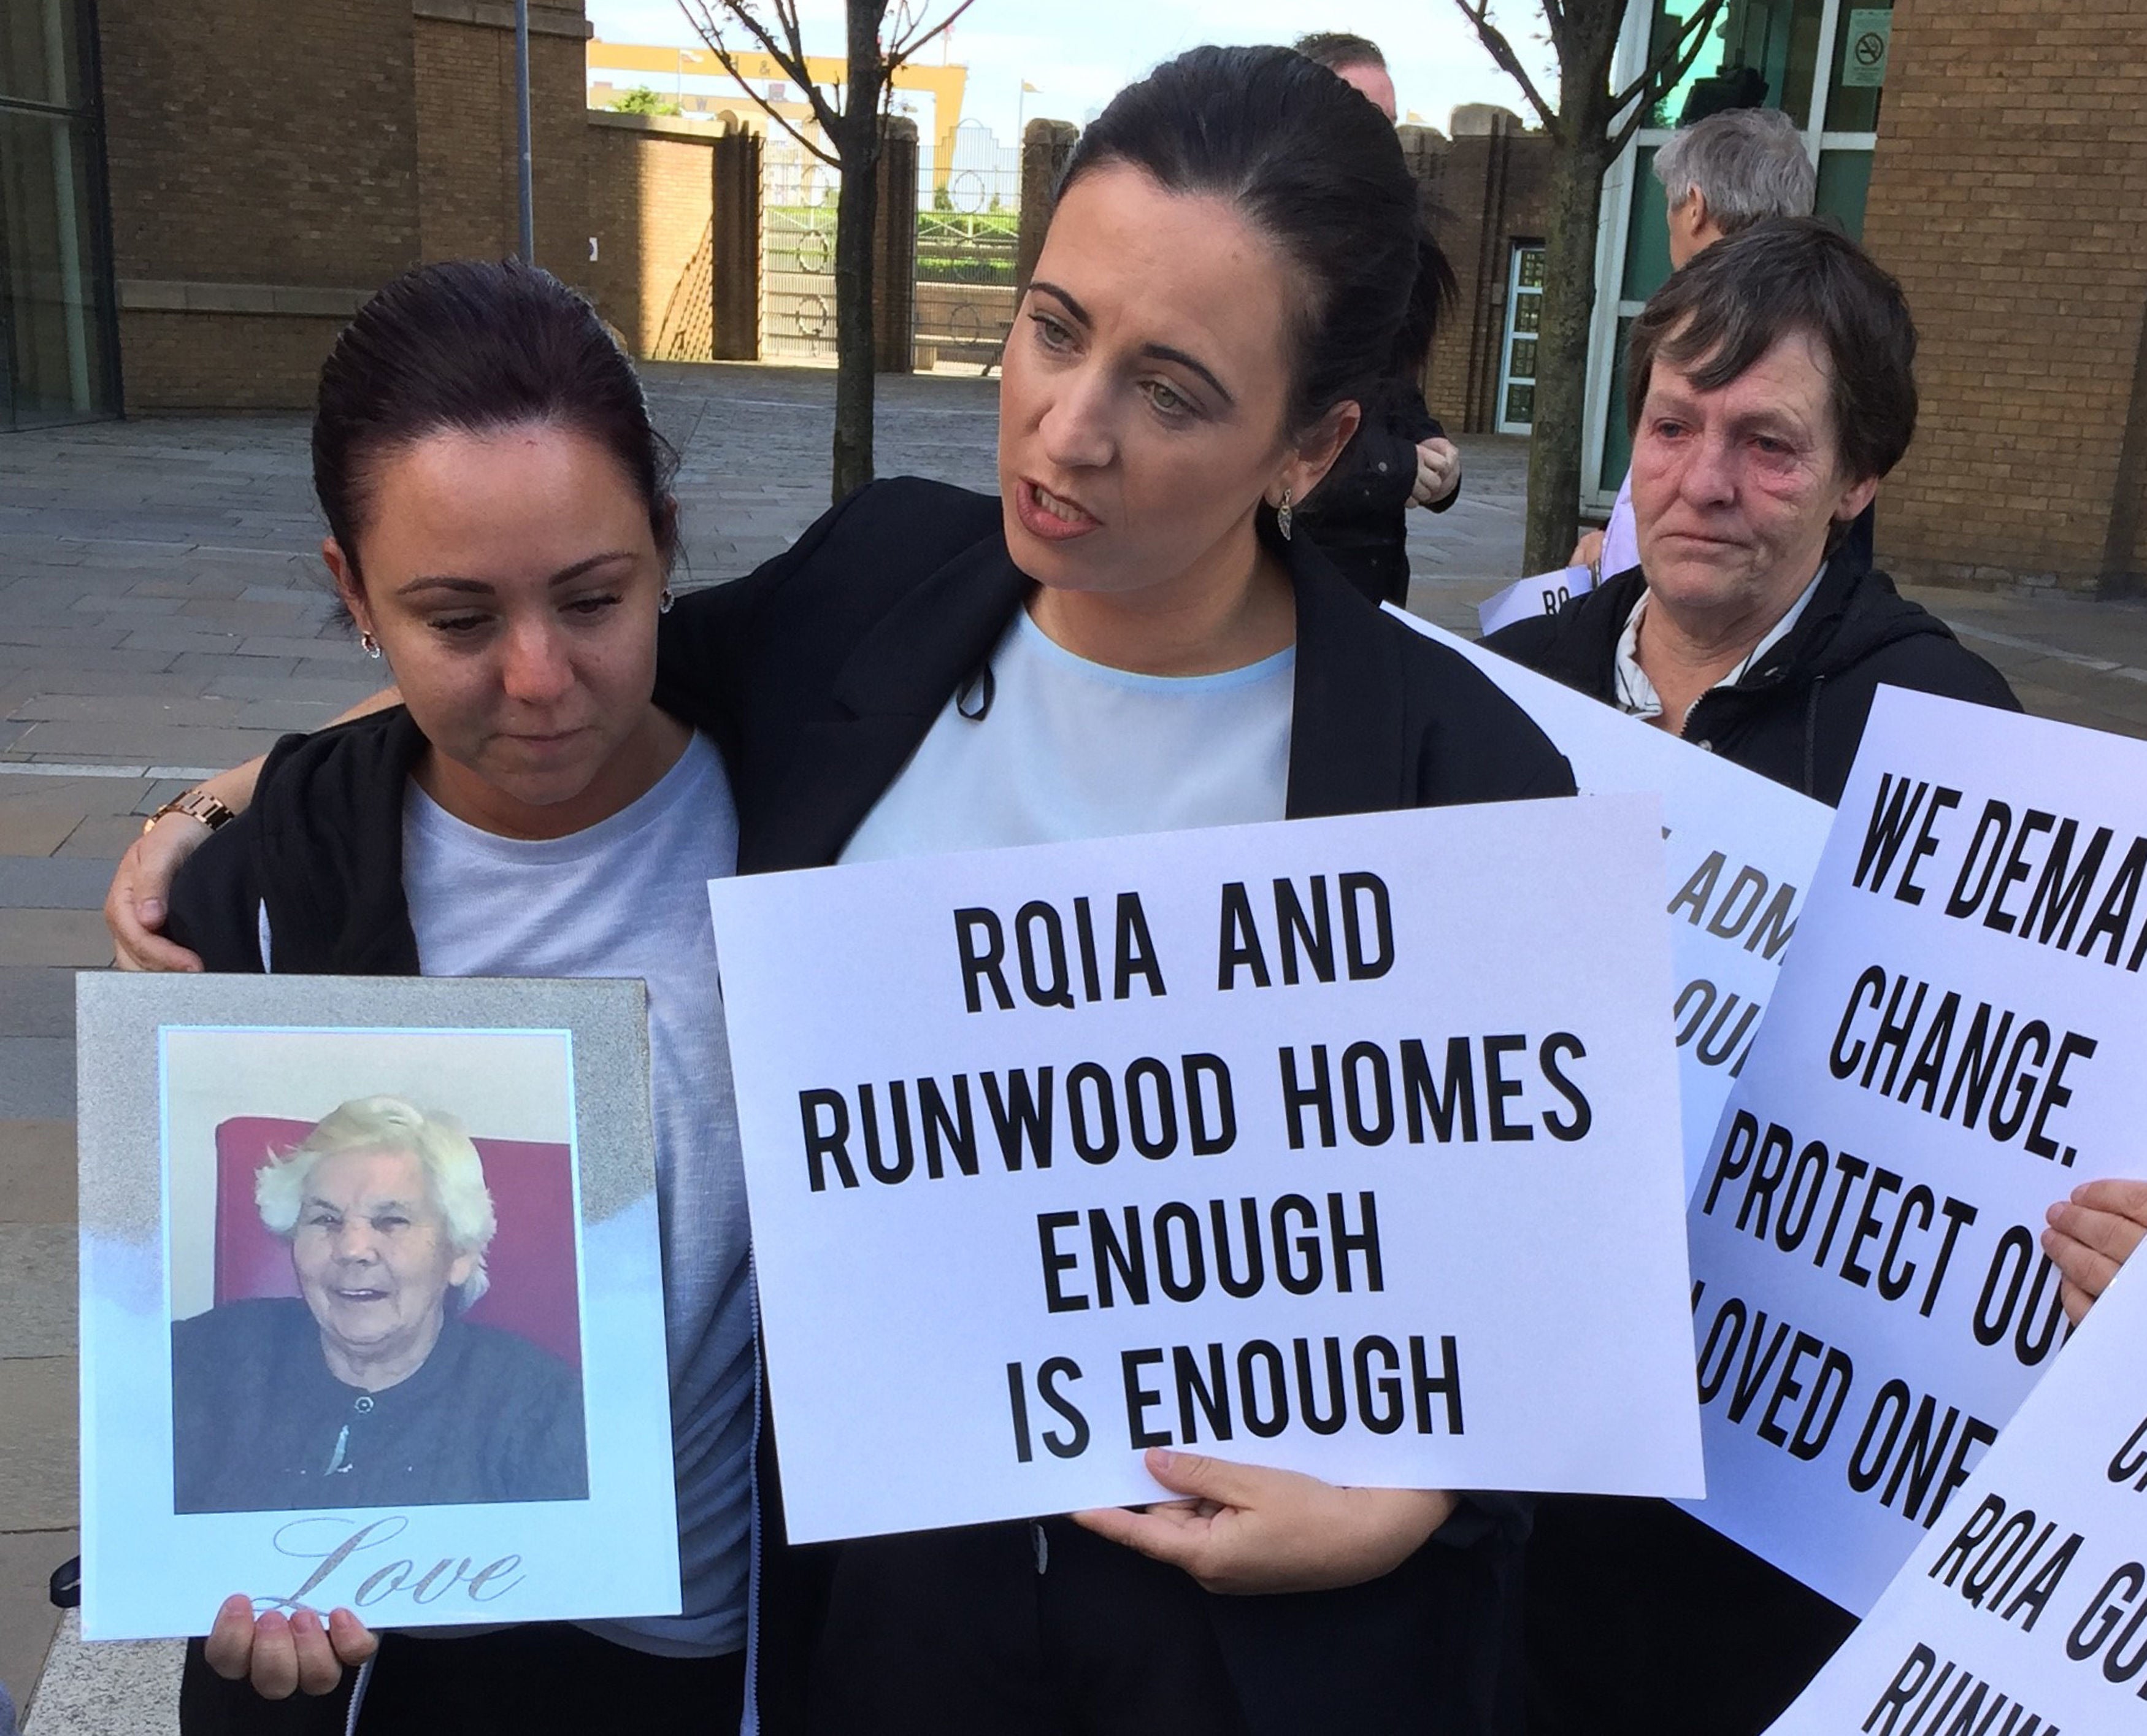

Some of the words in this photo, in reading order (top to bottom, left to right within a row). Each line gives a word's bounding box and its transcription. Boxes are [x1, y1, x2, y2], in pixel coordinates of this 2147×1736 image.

[1852, 772, 1963, 906] WE
[953, 896, 1167, 1013] RQIA
[1218, 871, 1395, 991] AND
[1673, 978, 1762, 1078] OU
[1829, 965, 2099, 1167] CHANGE.
[799, 1053, 1237, 1193] RUNWOOD
[1278, 1032, 1592, 1150] HOMES
[1037, 1191, 1385, 1314] ENOUGH
[1702, 1108, 1978, 1318] PROTECT
[1973, 1224, 2076, 1367] OU
[1007, 1356, 1090, 1463] IS
[1121, 1335, 1464, 1449] ENOUGH
[1691, 1279, 1854, 1462] OVED
[252, 1515, 526, 1616] Love
[1928, 1492, 2085, 1633] RQIA
